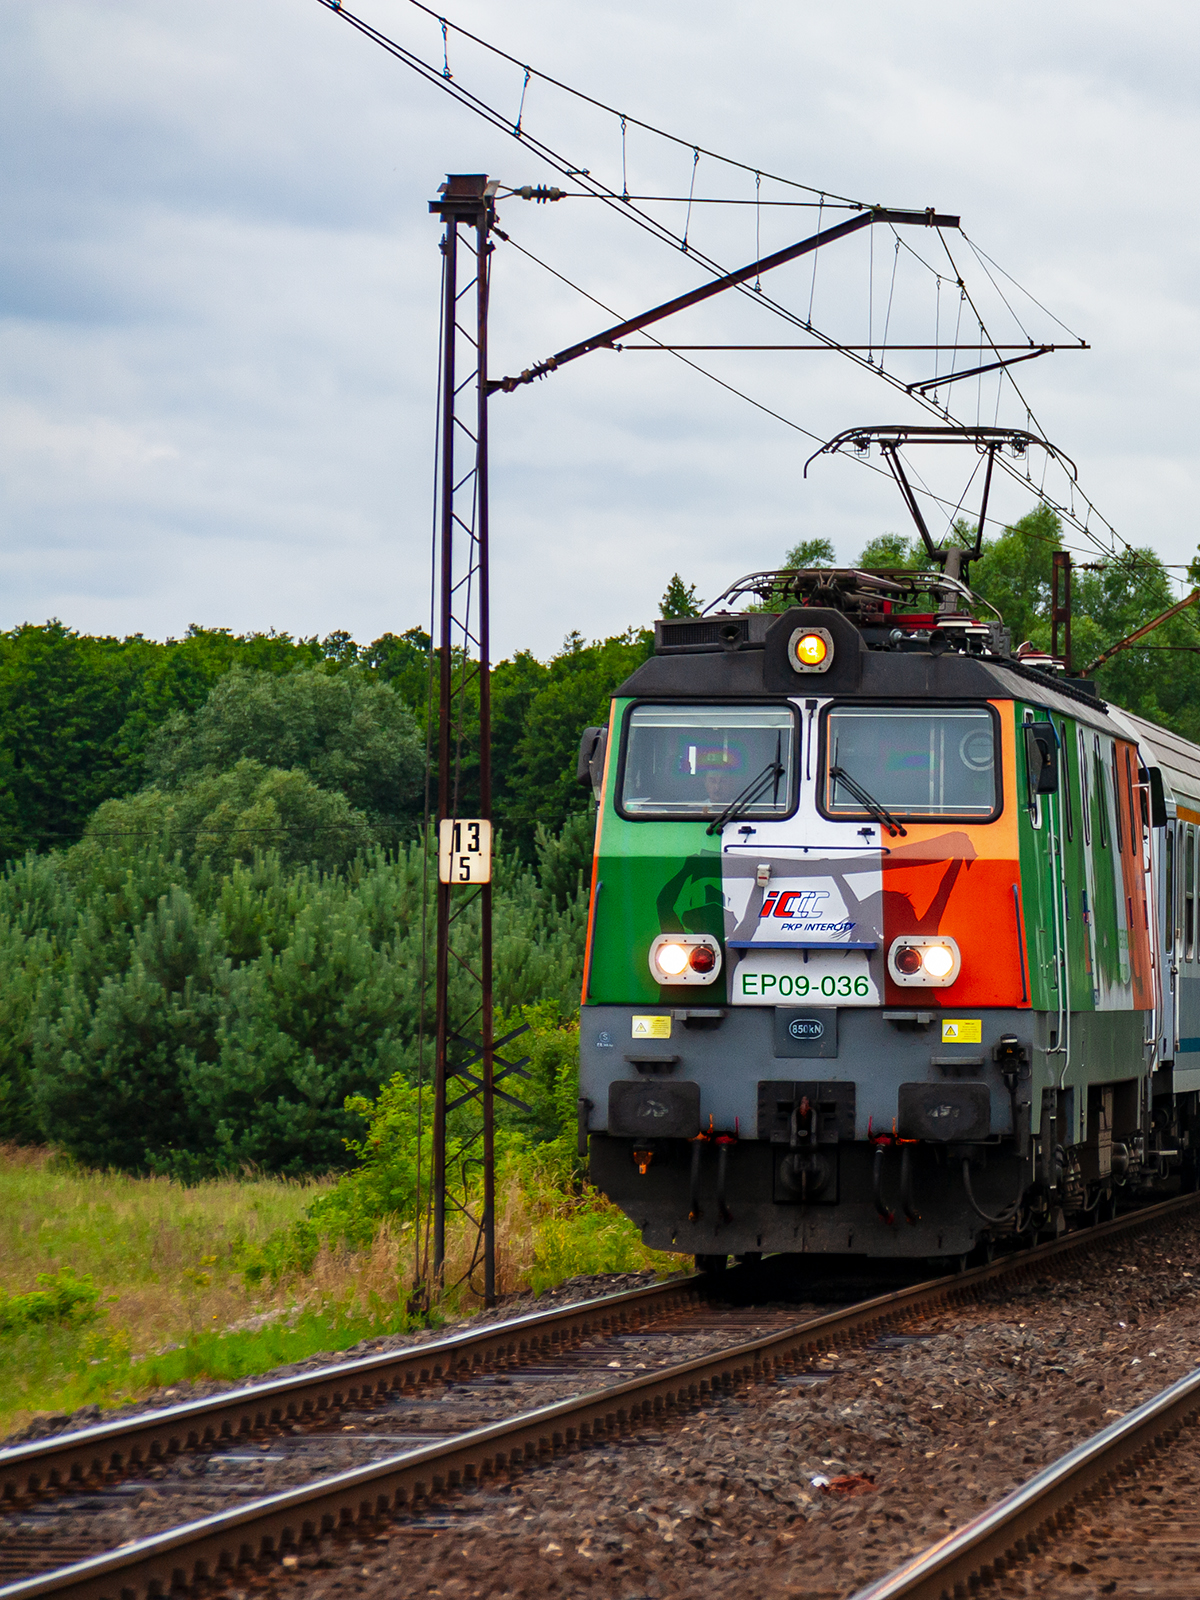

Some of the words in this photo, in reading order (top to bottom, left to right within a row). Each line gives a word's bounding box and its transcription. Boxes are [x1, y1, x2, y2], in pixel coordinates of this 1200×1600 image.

[454, 822, 480, 852] 13
[459, 856, 470, 881] 5
[780, 922, 803, 931] PKP
[803, 922, 857, 932] INTERCITY
[742, 973, 869, 997] EP09-036
